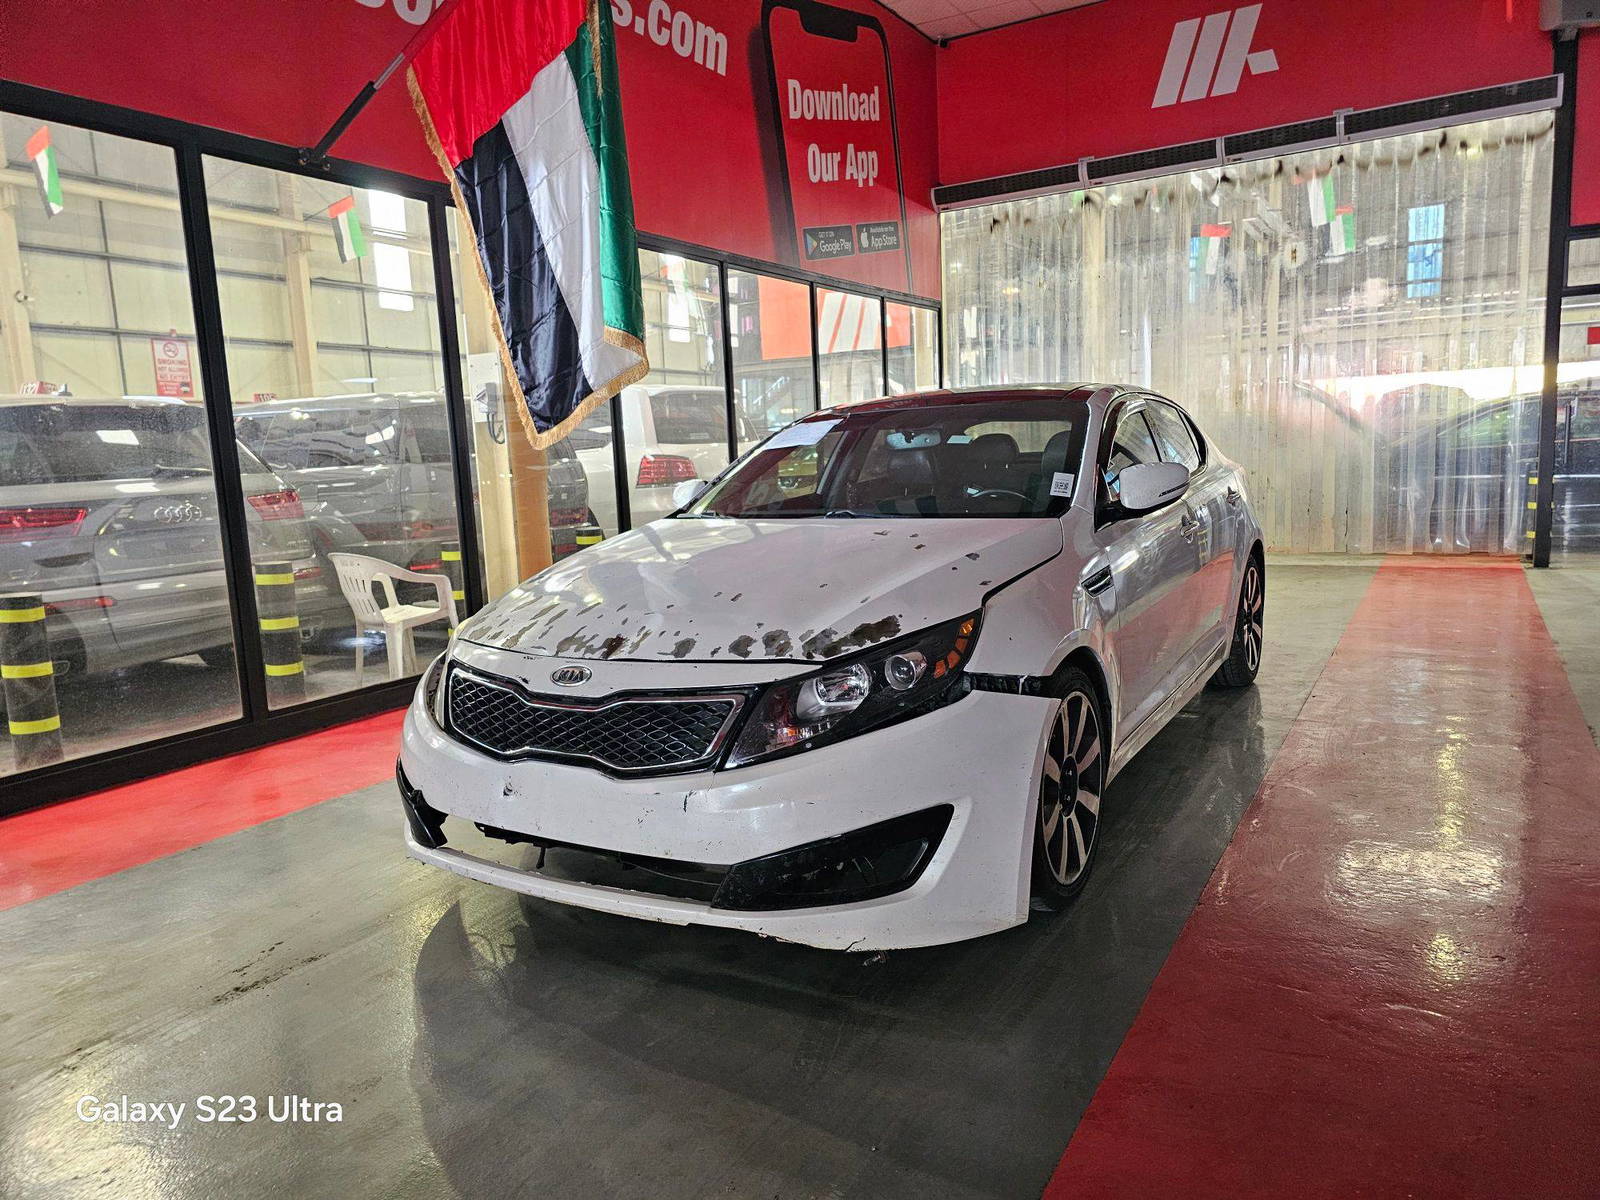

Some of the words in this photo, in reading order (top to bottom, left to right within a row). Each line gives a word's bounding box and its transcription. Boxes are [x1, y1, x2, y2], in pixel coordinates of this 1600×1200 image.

[787, 79, 880, 121] Download
[808, 143, 841, 183] Our
[845, 143, 879, 187] App
[820, 239, 841, 254] Google
[840, 238, 852, 252] Play
[871, 236, 882, 250] App
[882, 234, 897, 246] Store
[555, 668, 587, 683] KIA
